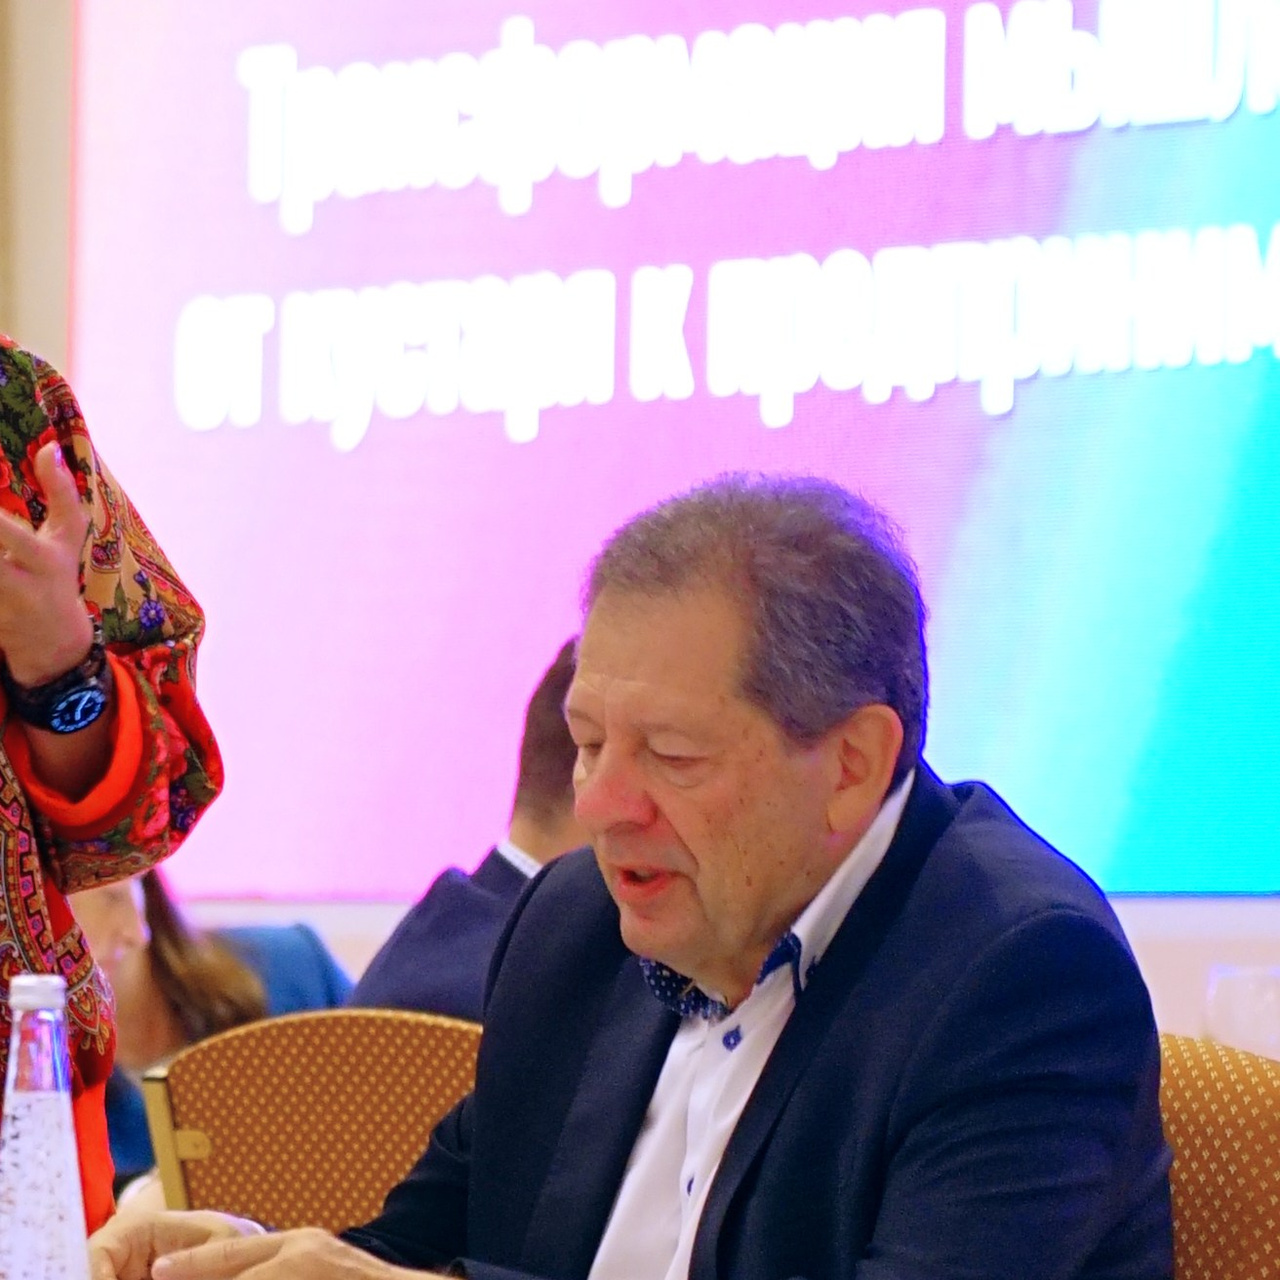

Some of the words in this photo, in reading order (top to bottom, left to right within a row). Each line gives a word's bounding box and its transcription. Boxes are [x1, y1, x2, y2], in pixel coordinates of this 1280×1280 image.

[174, 294, 275, 430] от
[279, 270, 615, 450] кустаря
[631, 265, 693, 400] к
